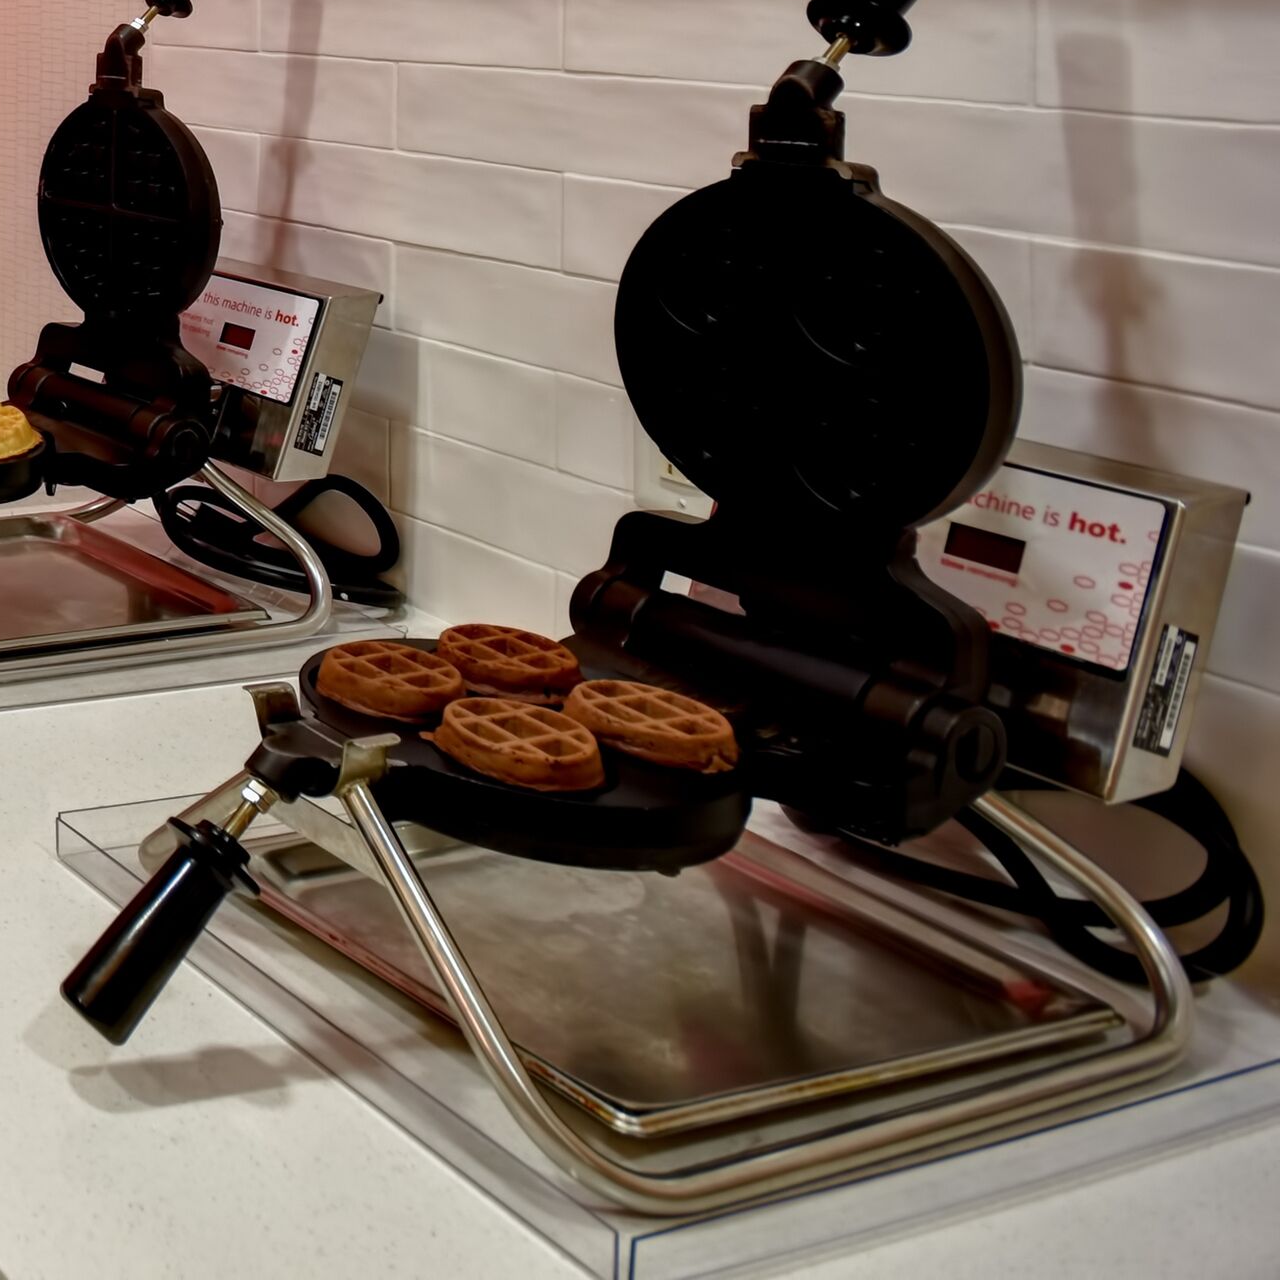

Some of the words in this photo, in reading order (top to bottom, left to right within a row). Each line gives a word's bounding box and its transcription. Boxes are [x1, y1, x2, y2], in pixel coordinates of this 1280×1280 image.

[203, 292, 220, 306] this
[221, 297, 263, 318] machine
[264, 309, 273, 320] is
[274, 309, 299, 327] hot.
[1042, 504, 1061, 528] is
[1068, 511, 1127, 545] hot.
